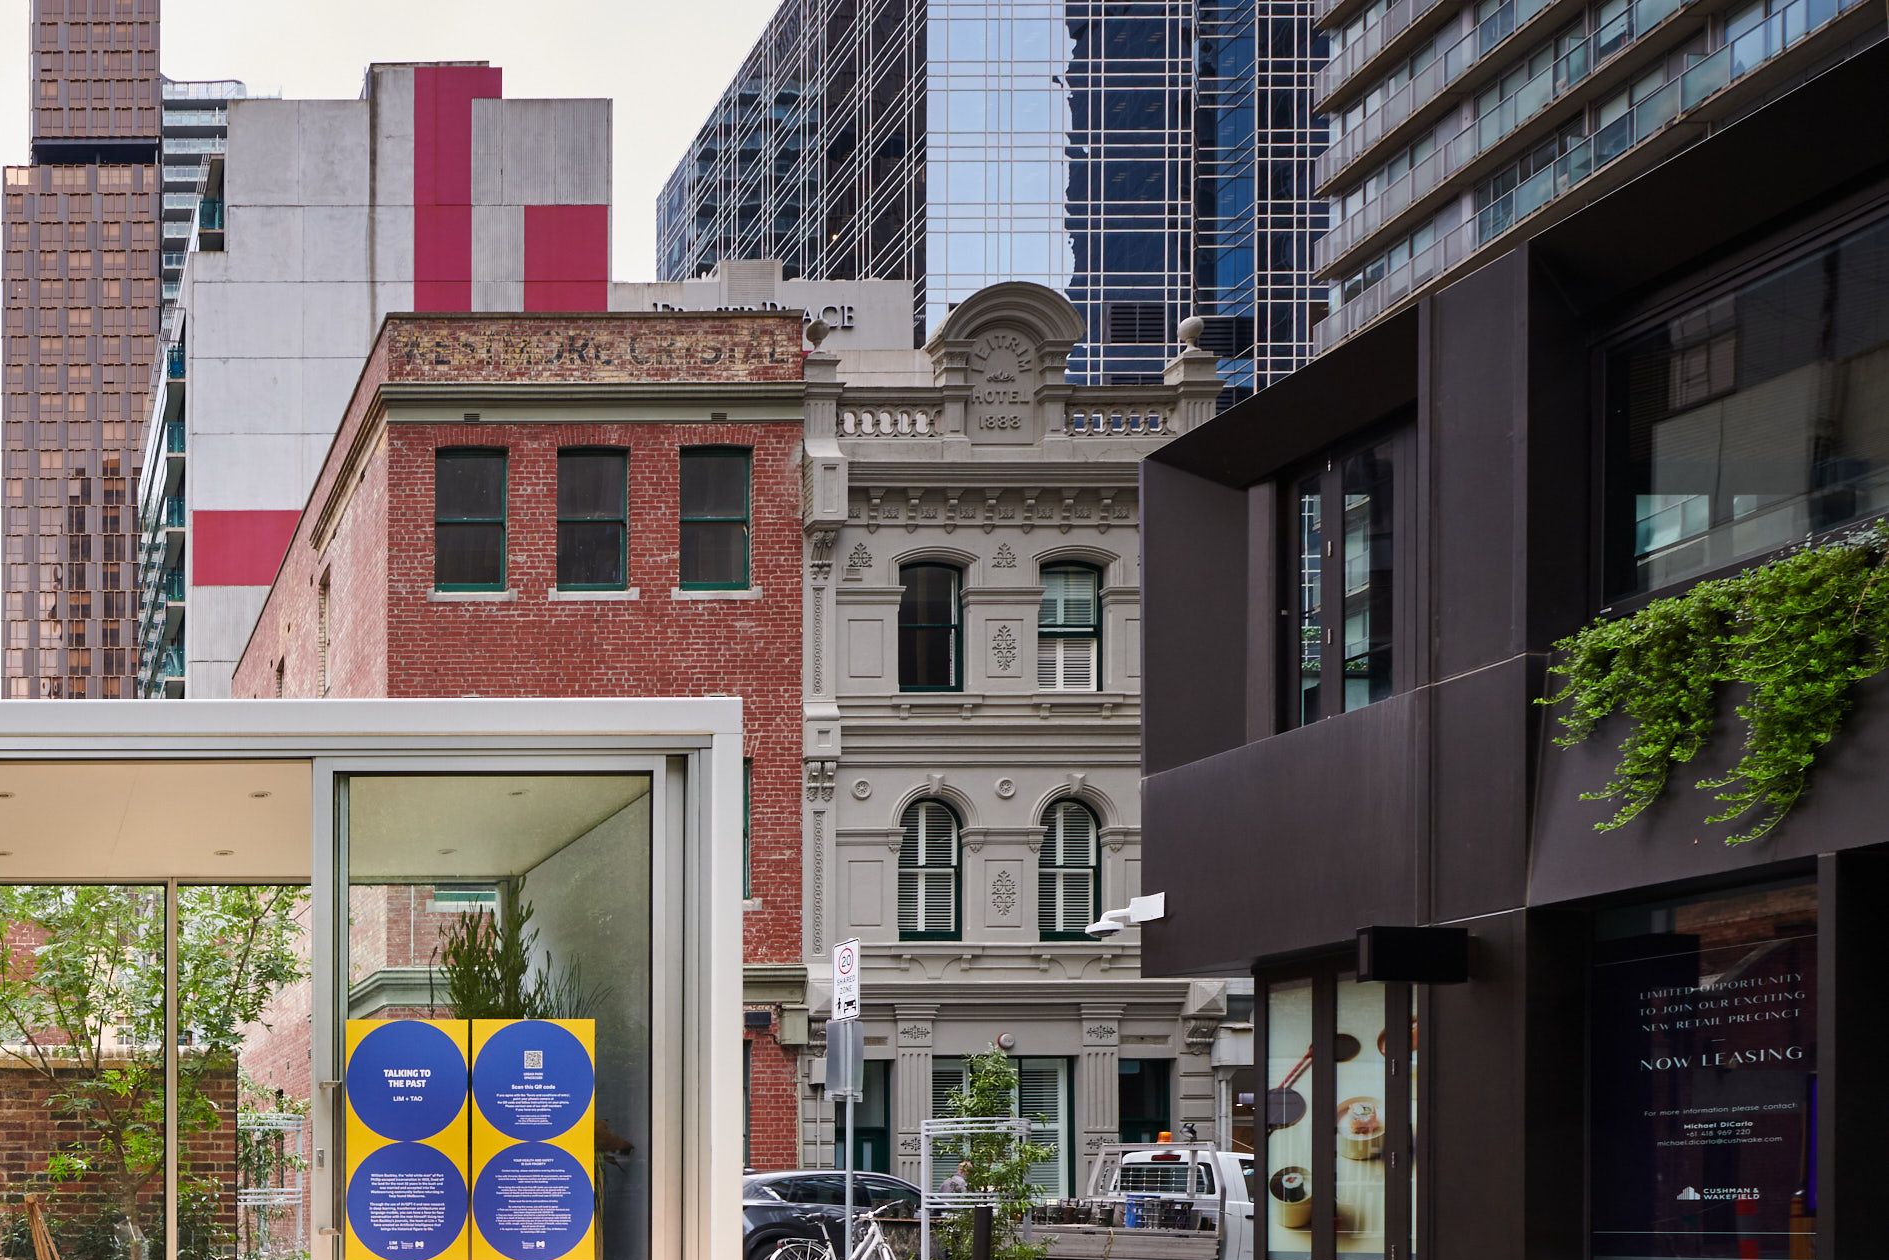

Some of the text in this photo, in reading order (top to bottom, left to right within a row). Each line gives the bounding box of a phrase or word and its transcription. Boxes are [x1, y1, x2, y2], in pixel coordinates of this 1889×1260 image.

[971, 334, 1033, 374] LEITRIM
[971, 389, 1030, 405] HOTEL
[979, 414, 1022, 430] 1888
[841, 955, 852, 968] 20
[837, 975, 856, 986] SHARED
[1640, 973, 1804, 1000] LIMITED OPPORTUNITY
[840, 985, 853, 994] ZONE
[1640, 990, 1806, 1016] TO JOIN OUR EXCITING
[1642, 1008, 1802, 1032] NEW RETAIL PRECINCT
[1641, 1045, 1803, 1071] NOW LEASING
[383, 1069, 431, 1077] TALKING TO
[1683, 1106, 1729, 1115] information
[1732, 1105, 1759, 1113] please
[1720, 1120, 1754, 1128] DiCarlo
